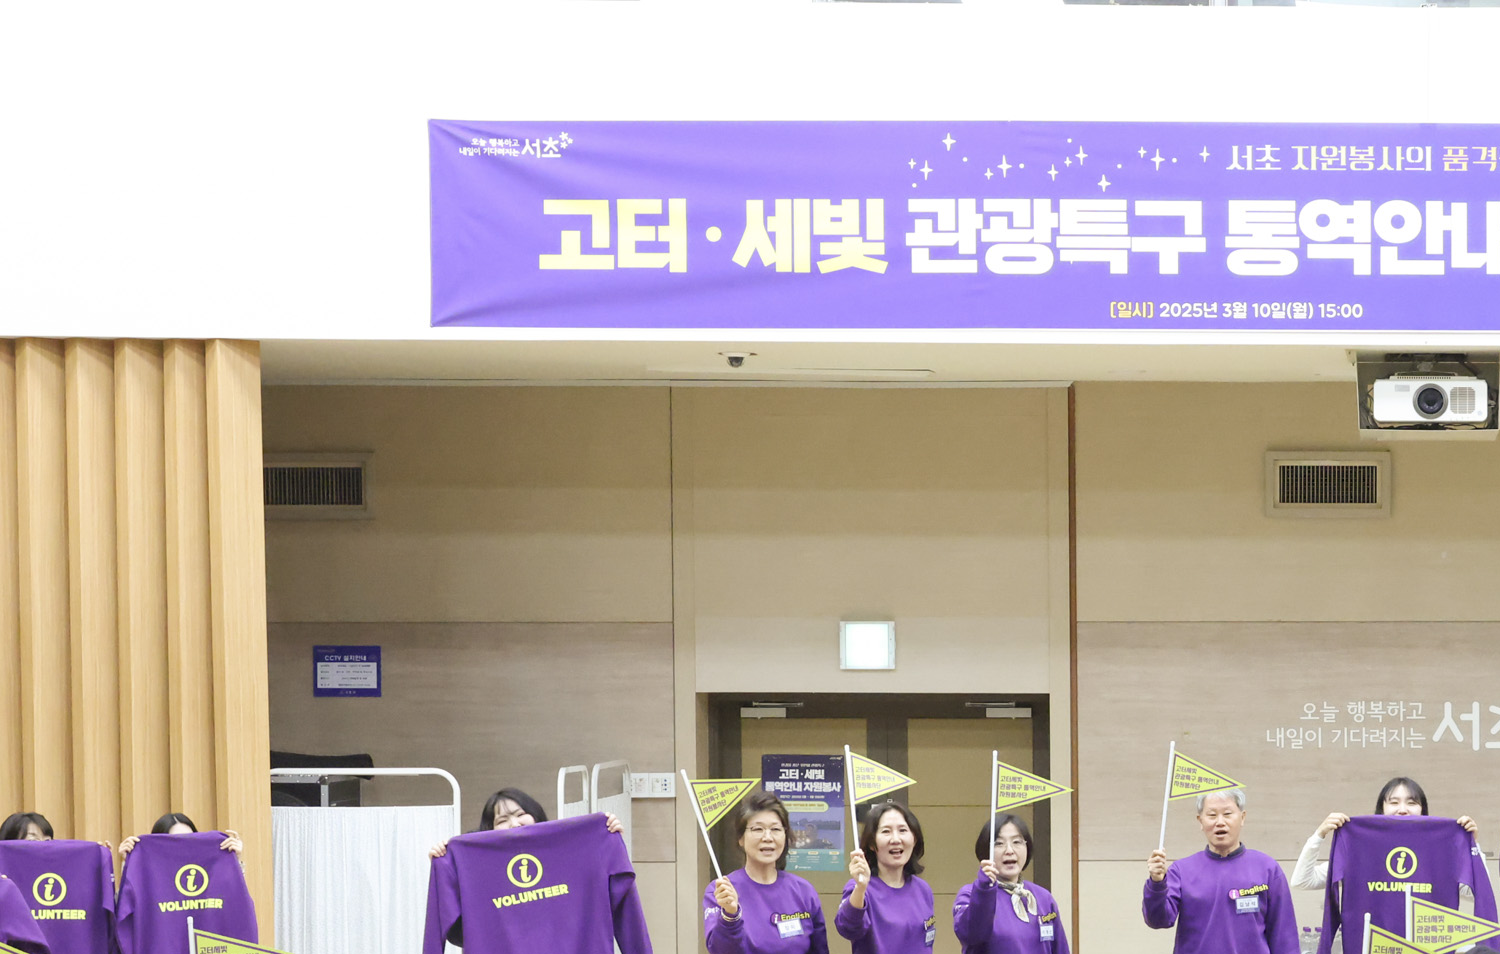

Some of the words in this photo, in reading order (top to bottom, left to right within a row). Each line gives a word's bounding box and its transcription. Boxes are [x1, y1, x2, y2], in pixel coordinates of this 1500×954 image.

[521, 137, 561, 158] 서초
[1226, 145, 1281, 170] 서초
[1292, 146, 1431, 171] 자원봉사의
[906, 199, 1206, 274] 관광특구
[1111, 302, 1153, 318] [일시]
[1160, 302, 1217, 318] 2025년
[1223, 302, 1247, 318] 3월
[1252, 302, 1313, 319] 10일(월)
[1319, 304, 1363, 318] 15:00
[1299, 702, 1340, 723] 오늘
[1346, 701, 1426, 723] 행복하고
[1266, 727, 1322, 749] 내일이
[1331, 727, 1426, 749] 기다려지는
[804, 782, 842, 792] 자원봉사
[493, 884, 569, 908] VOLUNTEER
[1239, 884, 1269, 896] English
[31, 909, 87, 920] LUNTEER
[158, 898, 223, 912] VOLUNTEER
[199, 945, 228, 954] 고터세빛
